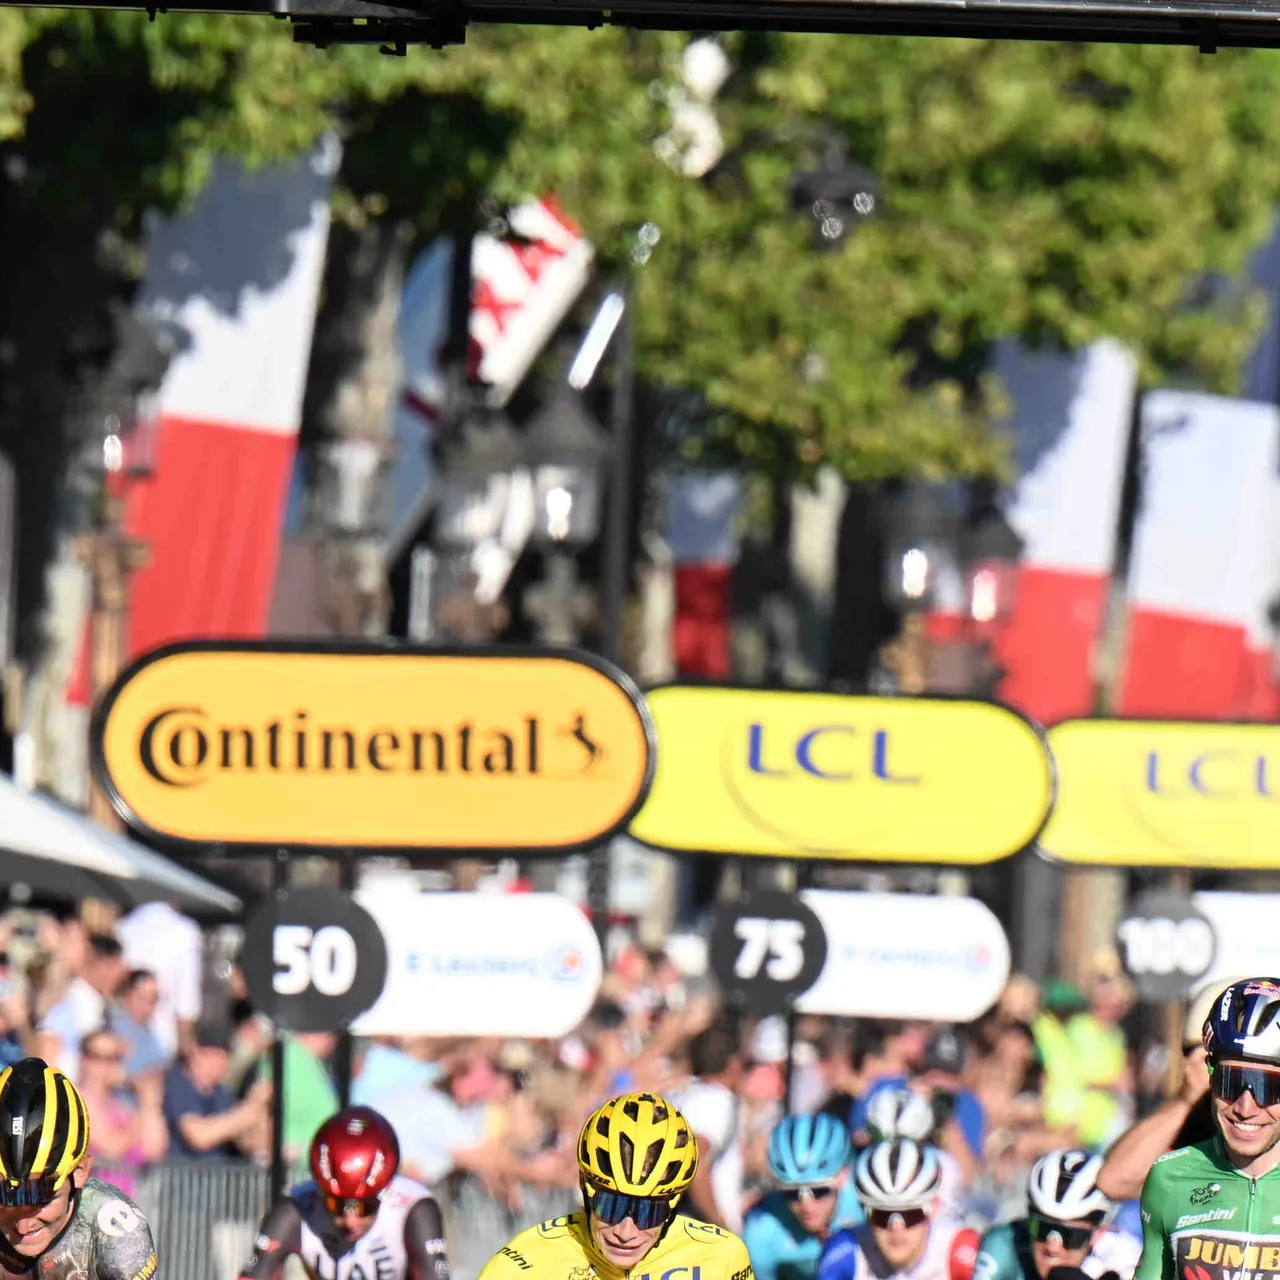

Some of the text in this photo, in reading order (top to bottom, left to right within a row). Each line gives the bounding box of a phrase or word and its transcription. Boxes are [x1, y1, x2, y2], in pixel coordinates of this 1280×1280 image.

[139, 707, 540, 787] Continental
[748, 722, 922, 784] LCL
[271, 924, 357, 996] 50
[734, 917, 805, 981] 75
[1120, 920, 1212, 975] 100
[688, 1220, 729, 1239] LCL
[1176, 1207, 1236, 1229] Santini
